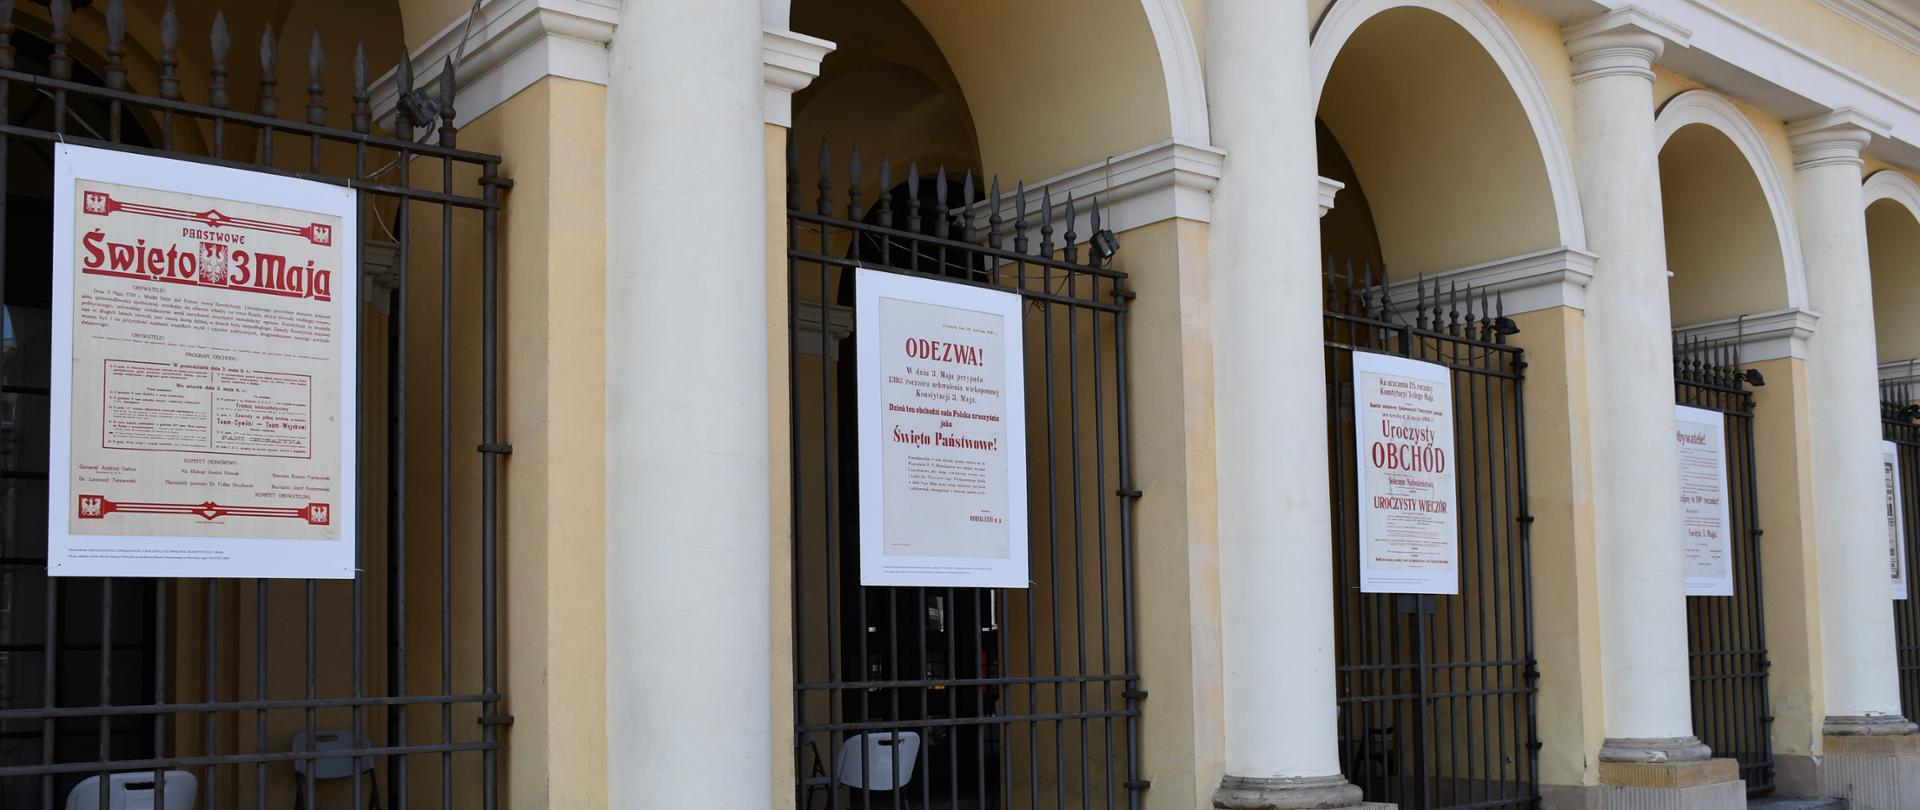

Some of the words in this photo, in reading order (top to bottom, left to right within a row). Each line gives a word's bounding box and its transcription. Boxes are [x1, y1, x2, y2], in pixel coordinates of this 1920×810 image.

[82, 228, 197, 281] Święto
[230, 248, 250, 285] 3
[254, 252, 330, 299] Maja
[905, 336, 983, 366] ODEZWA!
[906, 365, 912, 374] W
[940, 370, 954, 381] Maja
[889, 403, 904, 412] Dzień
[906, 405, 915, 413] ten
[915, 406, 939, 415] obchodzi
[953, 409, 970, 418] Polska
[940, 419, 952, 429] jako
[1382, 419, 1435, 446] Uroczysty
[894, 425, 930, 448] Święto
[936, 431, 998, 450] Państwowe!
[1371, 442, 1445, 474] OBCHÓD
[1373, 495, 1416, 511] UROCZYSTY
[1418, 498, 1446, 513] WIECZÓR
